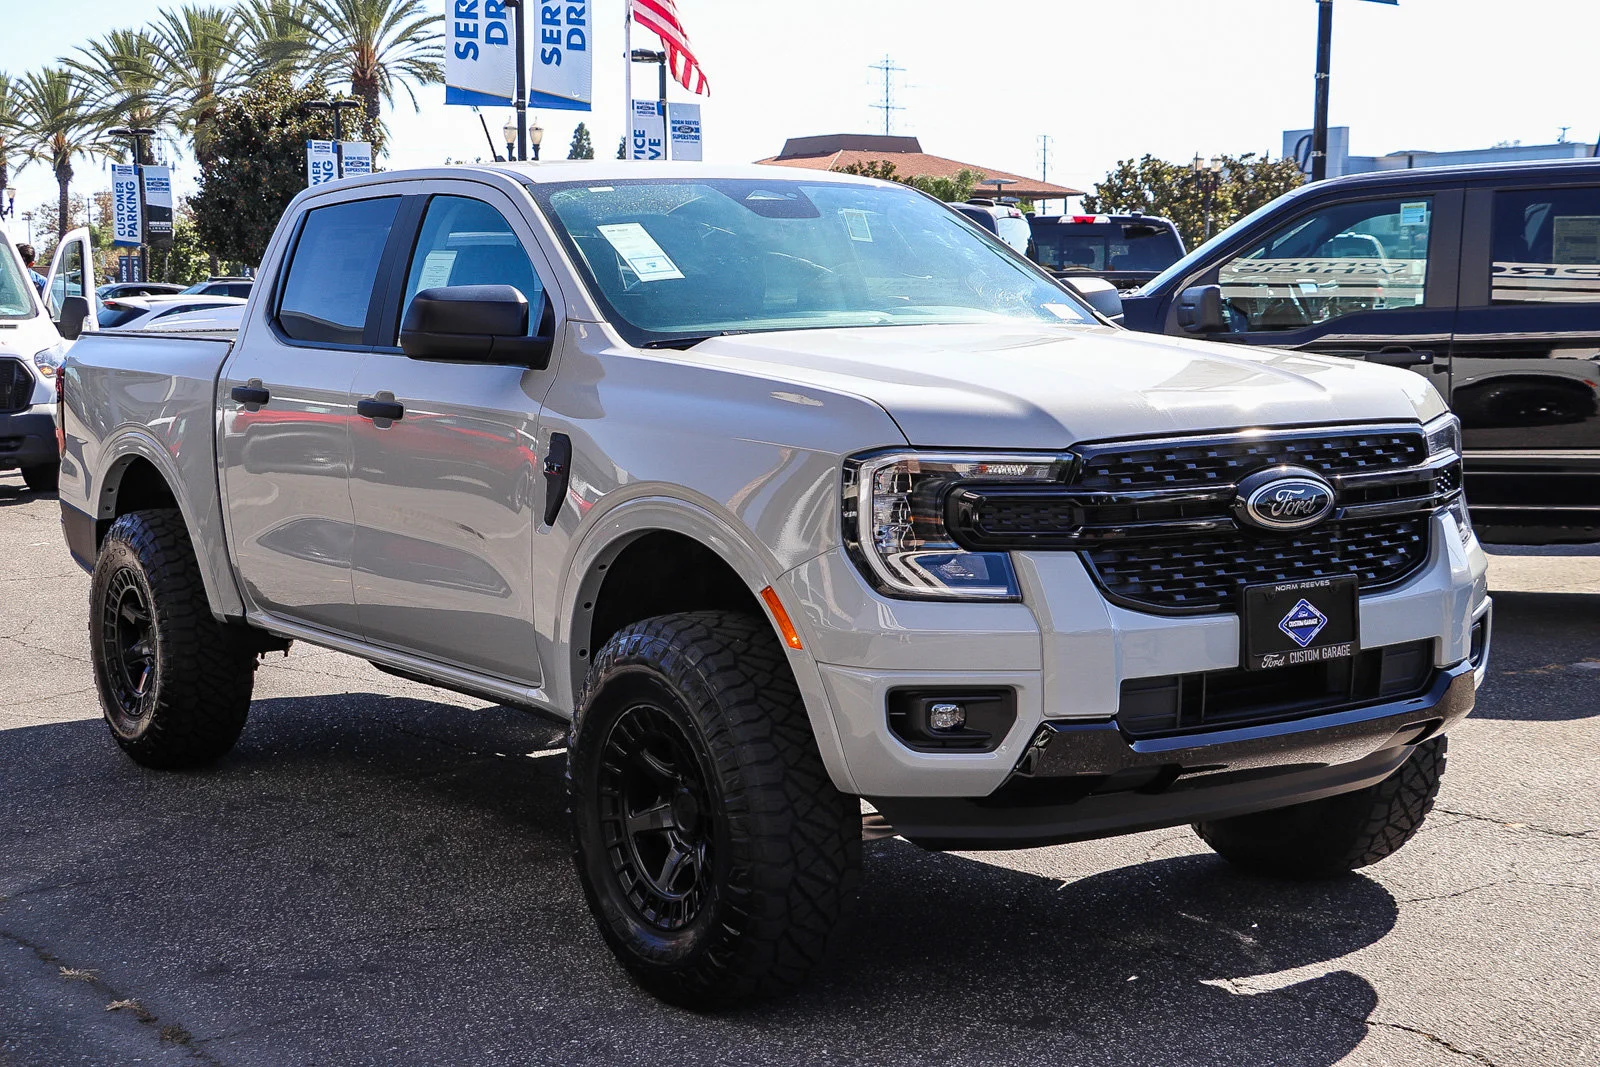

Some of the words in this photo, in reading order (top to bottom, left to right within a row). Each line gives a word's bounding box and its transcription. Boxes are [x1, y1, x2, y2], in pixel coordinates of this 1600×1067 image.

[541, 0, 562, 66] SER
[116, 182, 126, 237] CUSTOMER
[127, 181, 137, 238] PARKING
[1270, 488, 1317, 516] Ford
[1275, 583, 1298, 592] NORM
[1300, 579, 1330, 589] REEVES
[1297, 610, 1309, 618] Ford
[1261, 654, 1285, 668] Ford
[1289, 649, 1320, 664] CUSTOM
[1322, 644, 1351, 660] GARAGE
